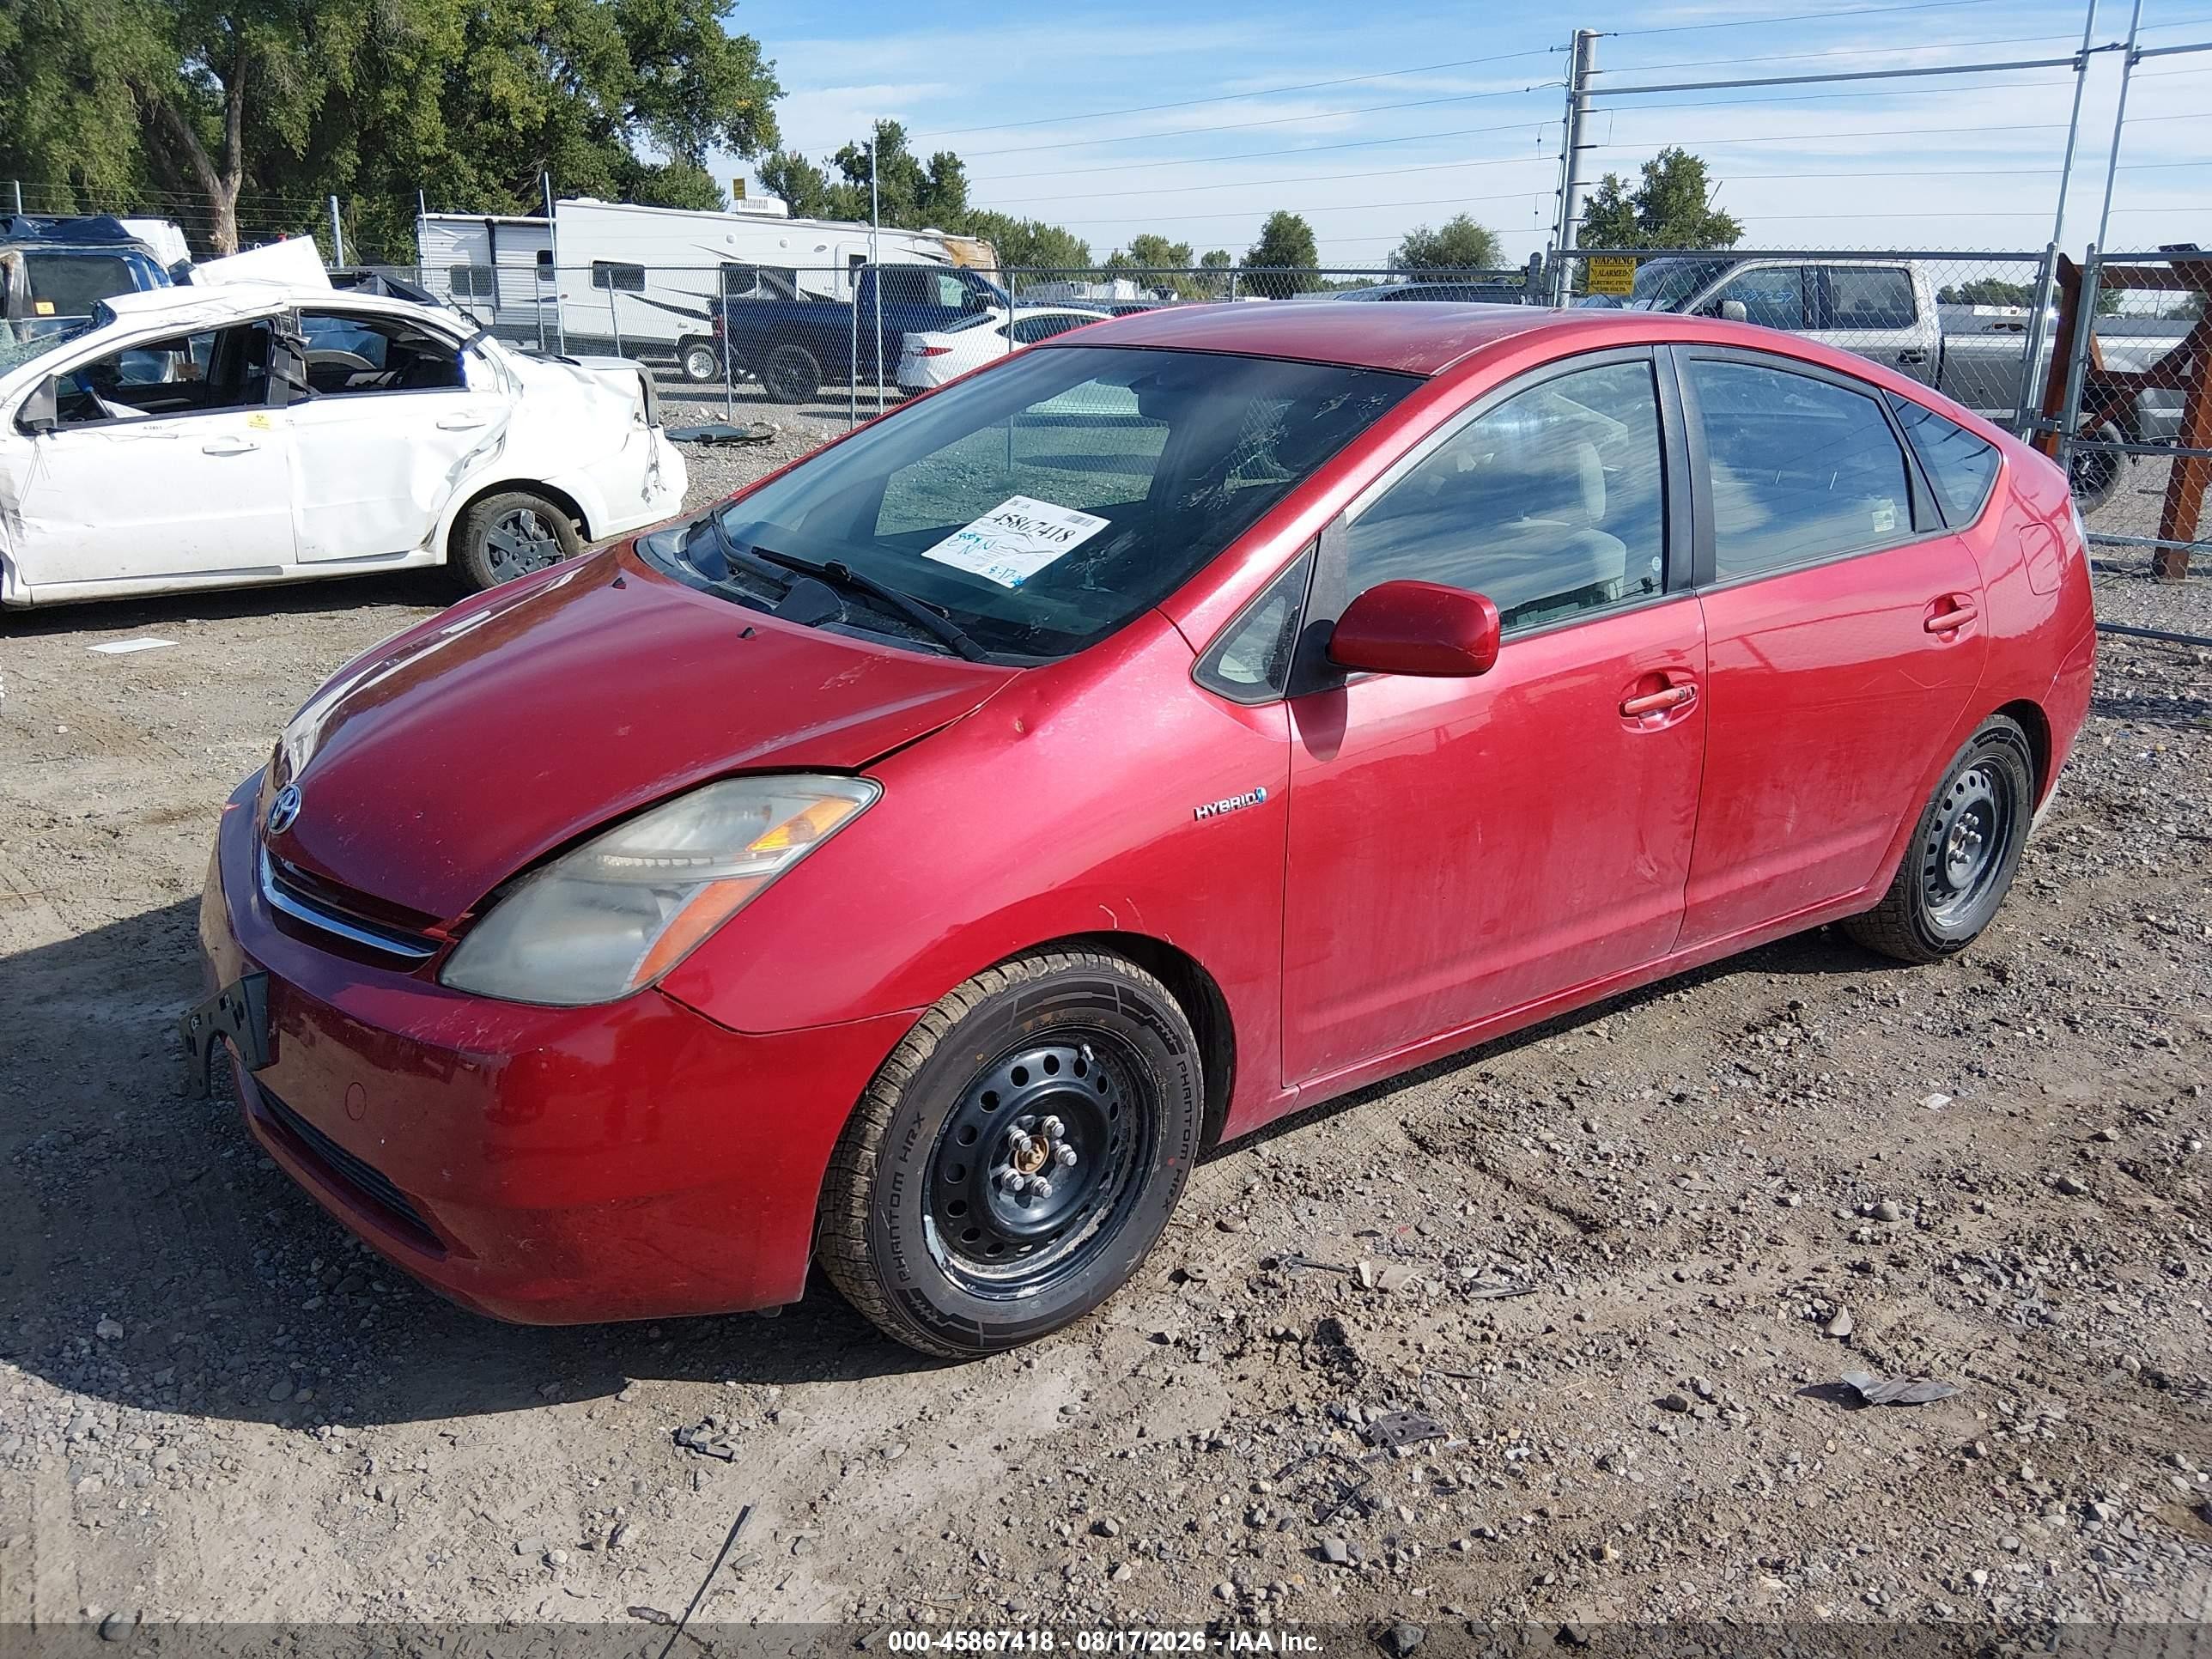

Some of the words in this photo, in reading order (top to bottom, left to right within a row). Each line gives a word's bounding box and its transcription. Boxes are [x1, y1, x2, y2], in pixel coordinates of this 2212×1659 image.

[1594, 257, 1633, 265] WARNING
[993, 513, 1077, 544] 45867418
[1194, 792, 1258, 821] HYBRID
[1176, 1060, 1193, 1160] PHANTOM
[898, 1112, 926, 1163] HRX
[1163, 1168, 1183, 1212] HRX
[889, 1171, 911, 1284] PHANTOM
